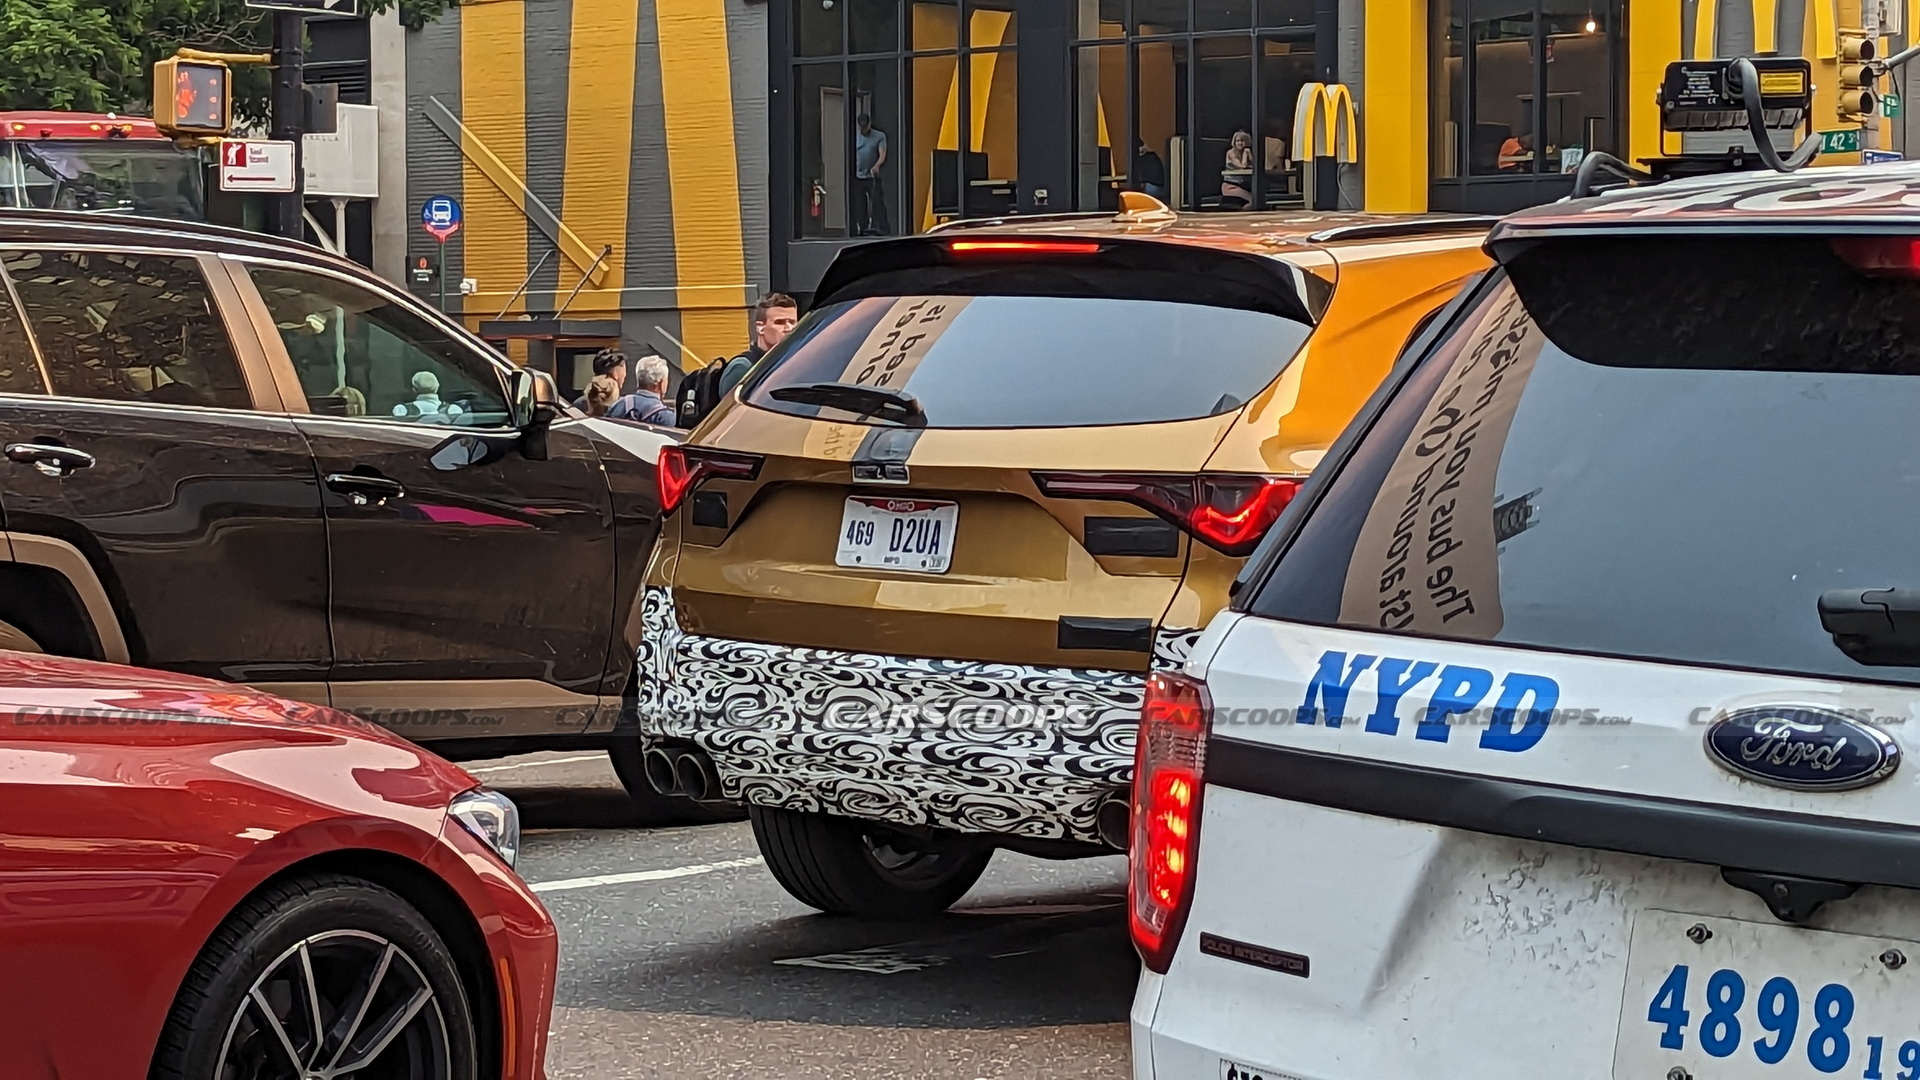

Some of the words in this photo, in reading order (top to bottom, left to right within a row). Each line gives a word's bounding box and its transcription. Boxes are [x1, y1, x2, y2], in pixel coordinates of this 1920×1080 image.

[1830, 133, 1845, 150] 42
[846, 520, 875, 547] 469
[889, 518, 942, 555] D2UA
[1295, 650, 1561, 753] NYPD
[1741, 717, 1847, 772] Ford
[1648, 964, 1855, 1074] 4898
